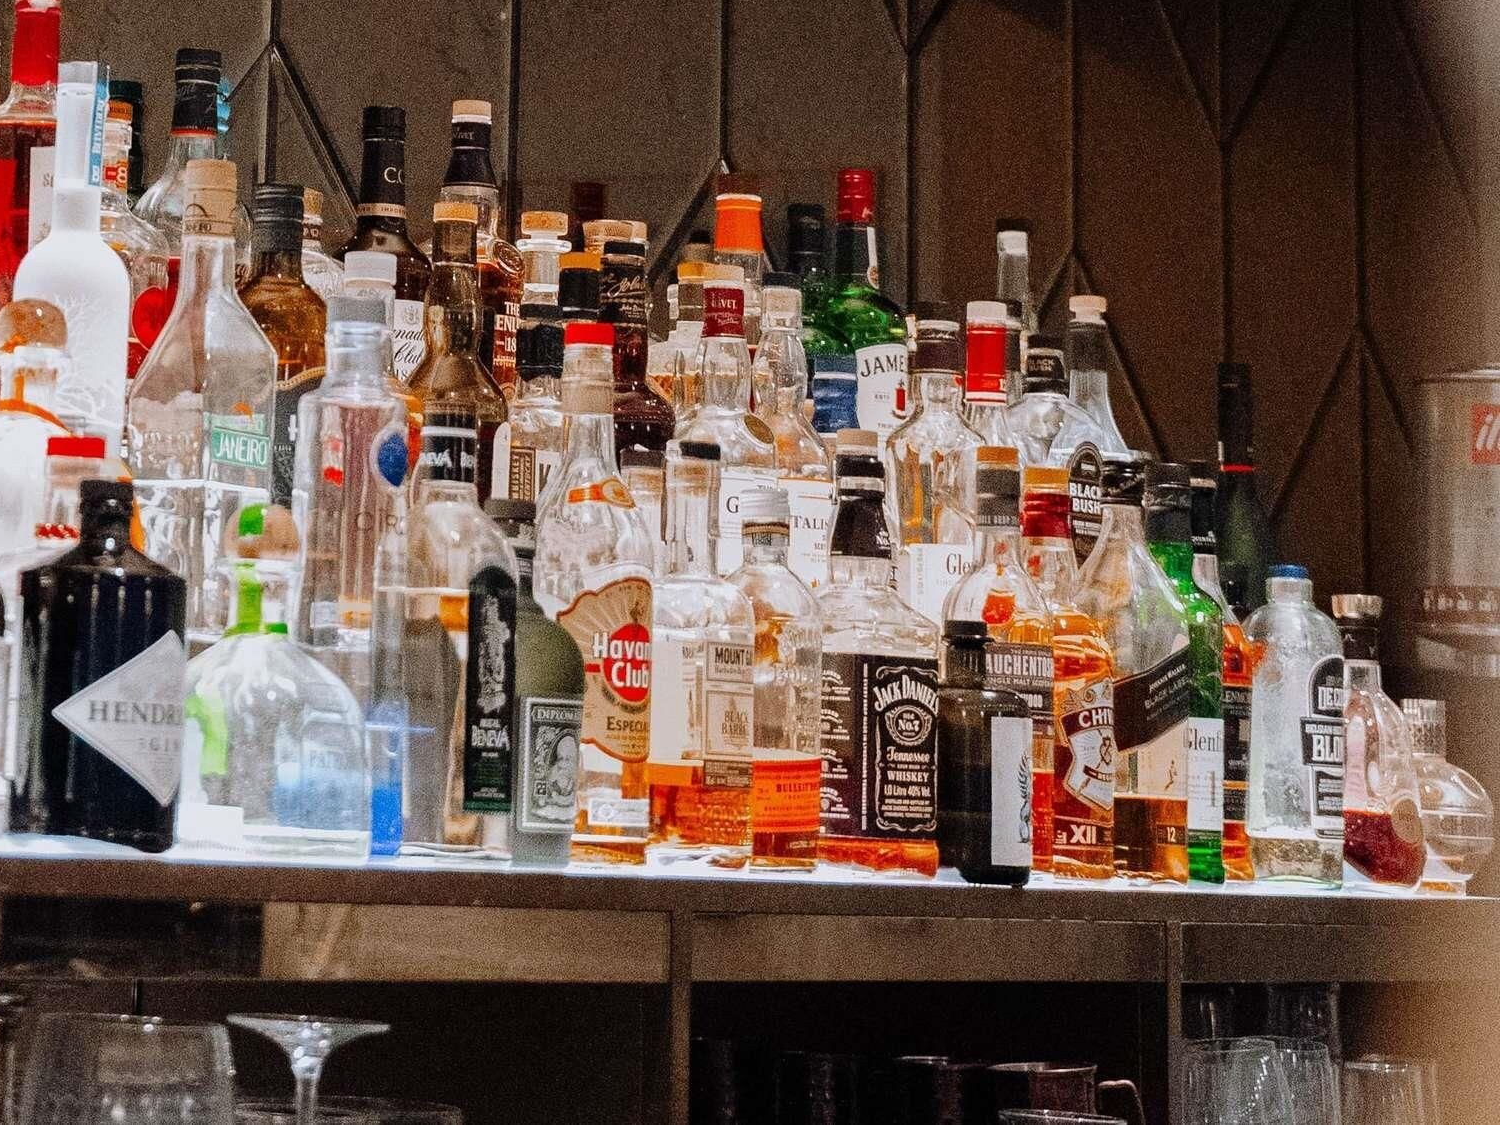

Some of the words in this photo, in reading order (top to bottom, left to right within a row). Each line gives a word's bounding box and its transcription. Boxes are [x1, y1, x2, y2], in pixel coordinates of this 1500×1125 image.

[214, 432, 268, 465] JANEIRO
[610, 661, 649, 688] Club
[873, 681, 902, 712] JACK
[886, 746, 930, 763] Tennessee
[887, 770, 930, 783] WHISKEY
[1069, 824, 1097, 845] XII
[1166, 826, 1176, 843] 12
